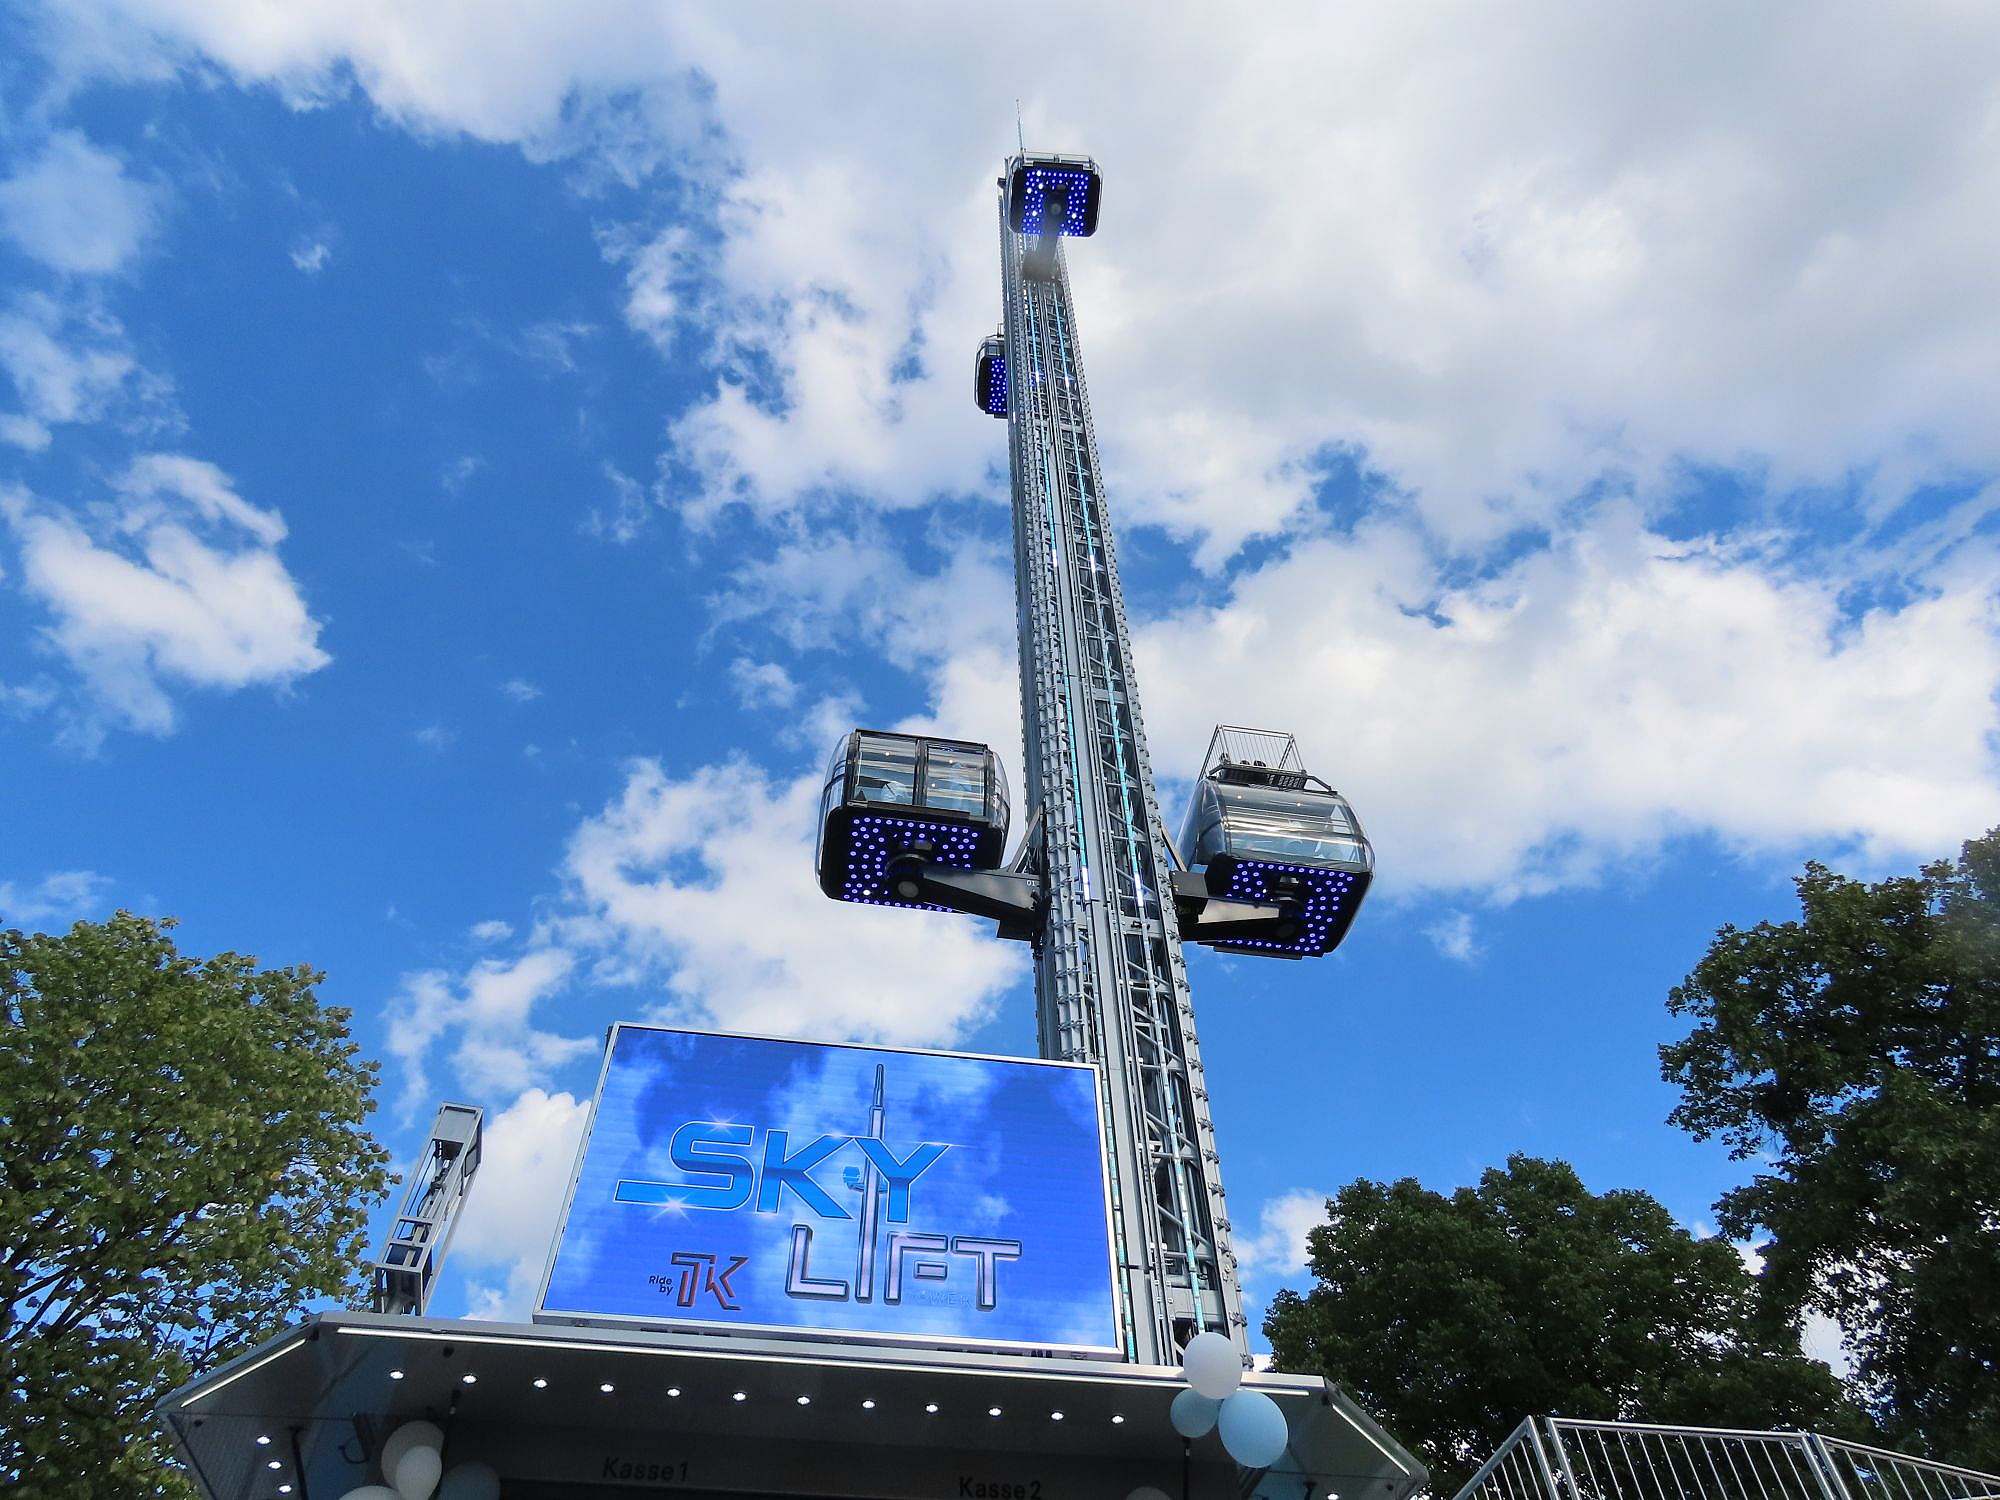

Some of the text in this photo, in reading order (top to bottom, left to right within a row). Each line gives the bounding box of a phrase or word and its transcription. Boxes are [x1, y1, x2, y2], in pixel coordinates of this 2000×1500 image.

[613, 1120, 951, 1223] SKY
[648, 1275, 673, 1285] Ride
[659, 1284, 674, 1296] by
[784, 1224, 1022, 1311] LIFT
